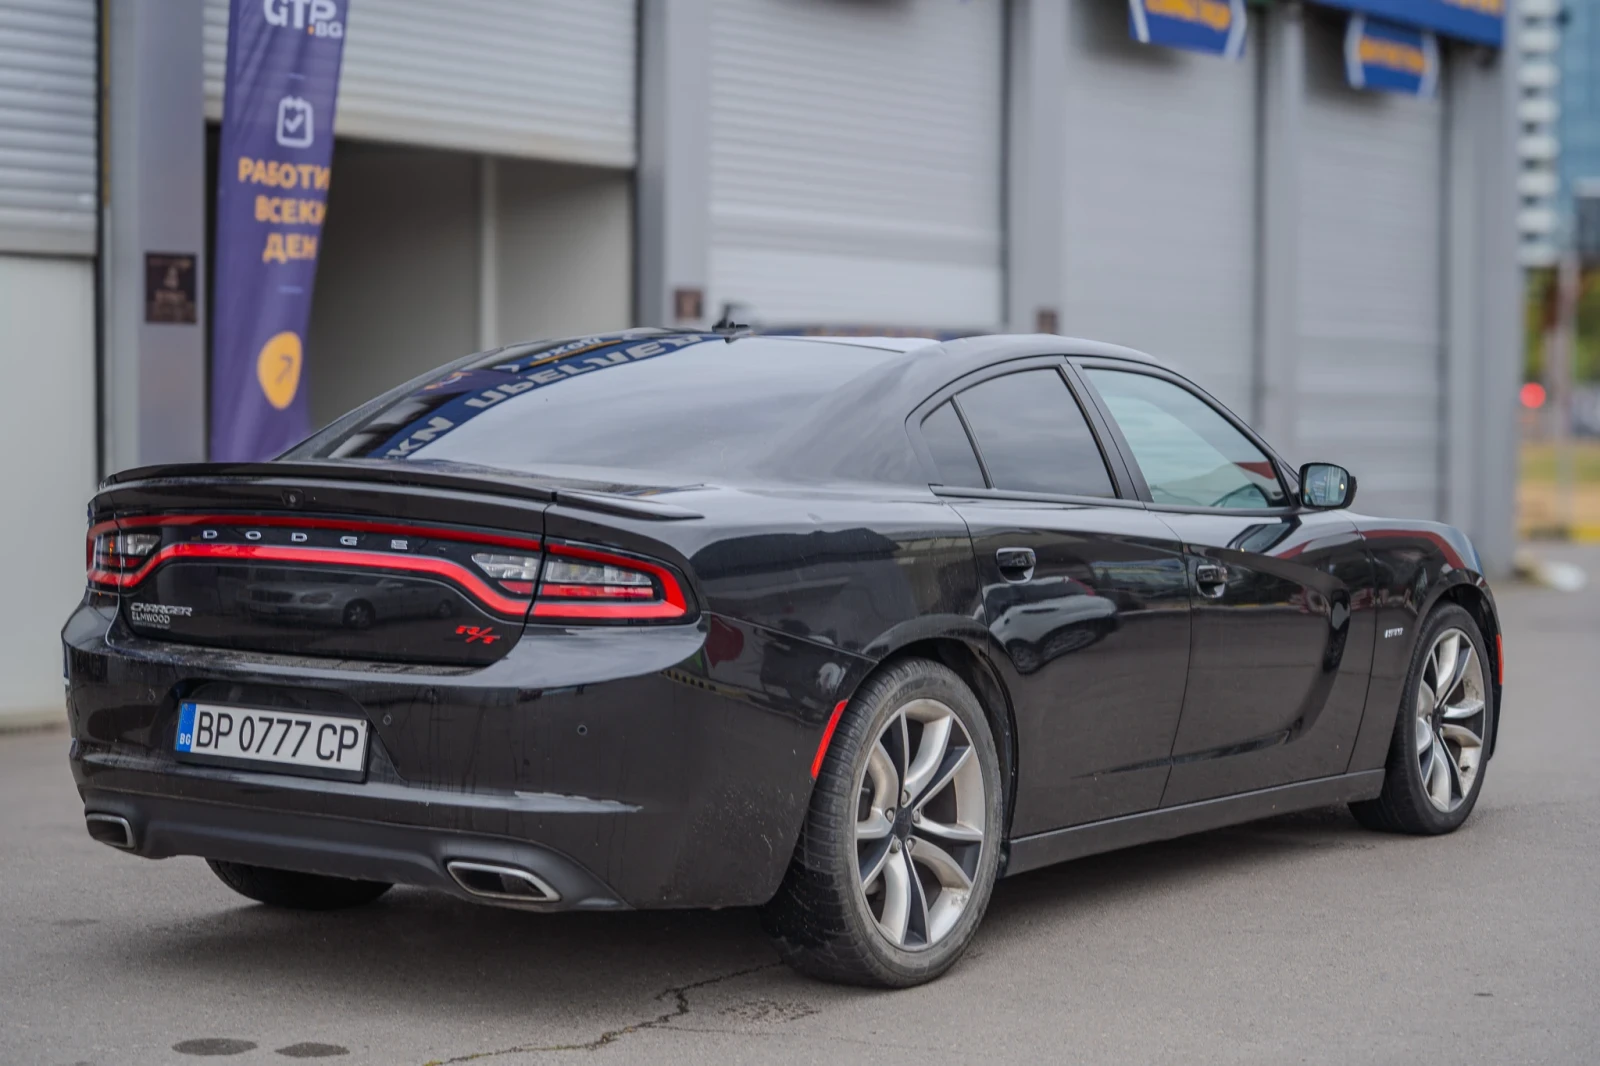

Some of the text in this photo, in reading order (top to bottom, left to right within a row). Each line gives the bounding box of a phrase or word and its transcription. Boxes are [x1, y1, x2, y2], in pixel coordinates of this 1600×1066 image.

[262, 232, 317, 264] ДЕН
[203, 530, 408, 550] DODGE
[131, 602, 192, 616] CHARGER
[132, 611, 170, 624] ELMWOOD
[179, 733, 191, 745] BG
[196, 711, 359, 762] BP 0777 CP
